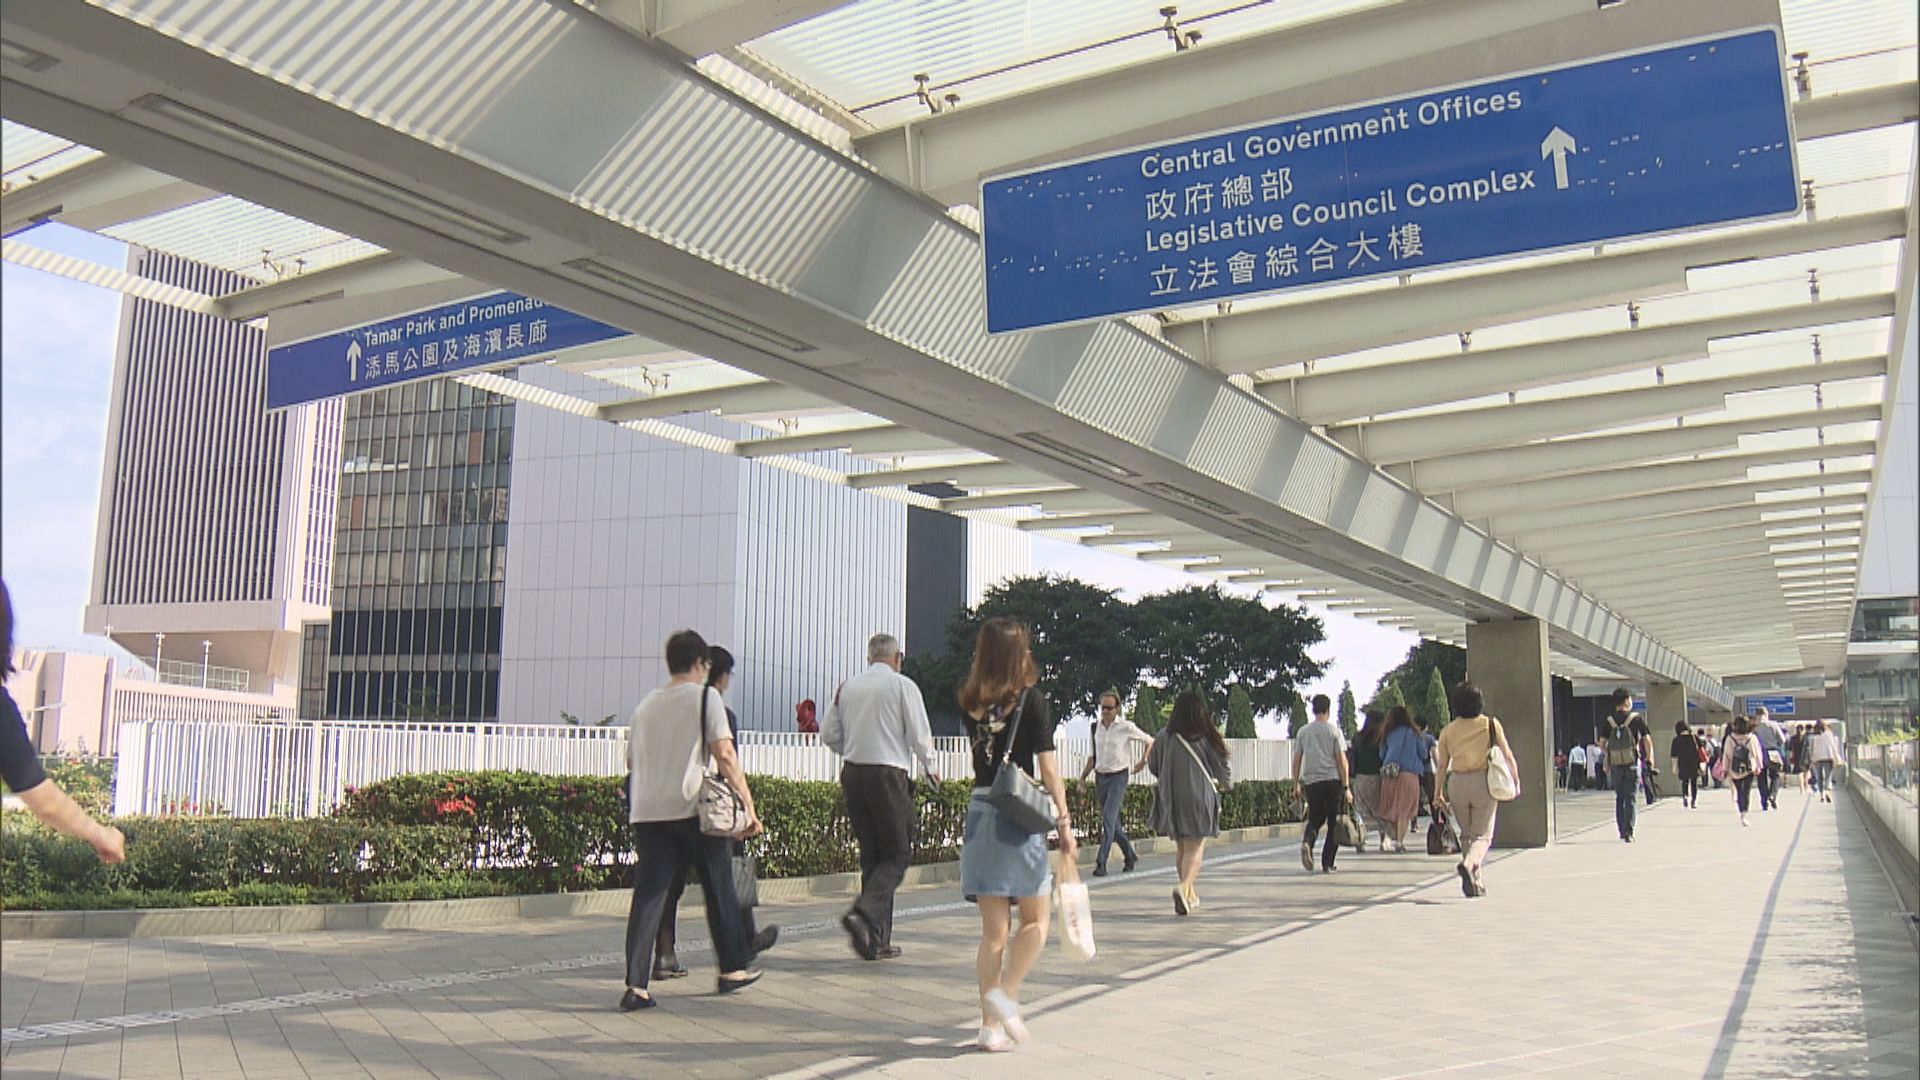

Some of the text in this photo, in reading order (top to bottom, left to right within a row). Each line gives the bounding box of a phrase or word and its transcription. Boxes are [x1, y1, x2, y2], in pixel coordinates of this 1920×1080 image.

[1141, 90, 1522, 178] Central Government Offices
[1145, 167, 1293, 222] 政府總部
[1146, 169, 1536, 252] Legislative Council Complex
[1150, 222, 1424, 296] 立法會綜合大樓
[364, 328, 403, 348] Tamar
[406, 316, 436, 338] Park
[440, 308, 465, 330] and
[364, 318, 548, 381] 添馬公園及海濱長廊
